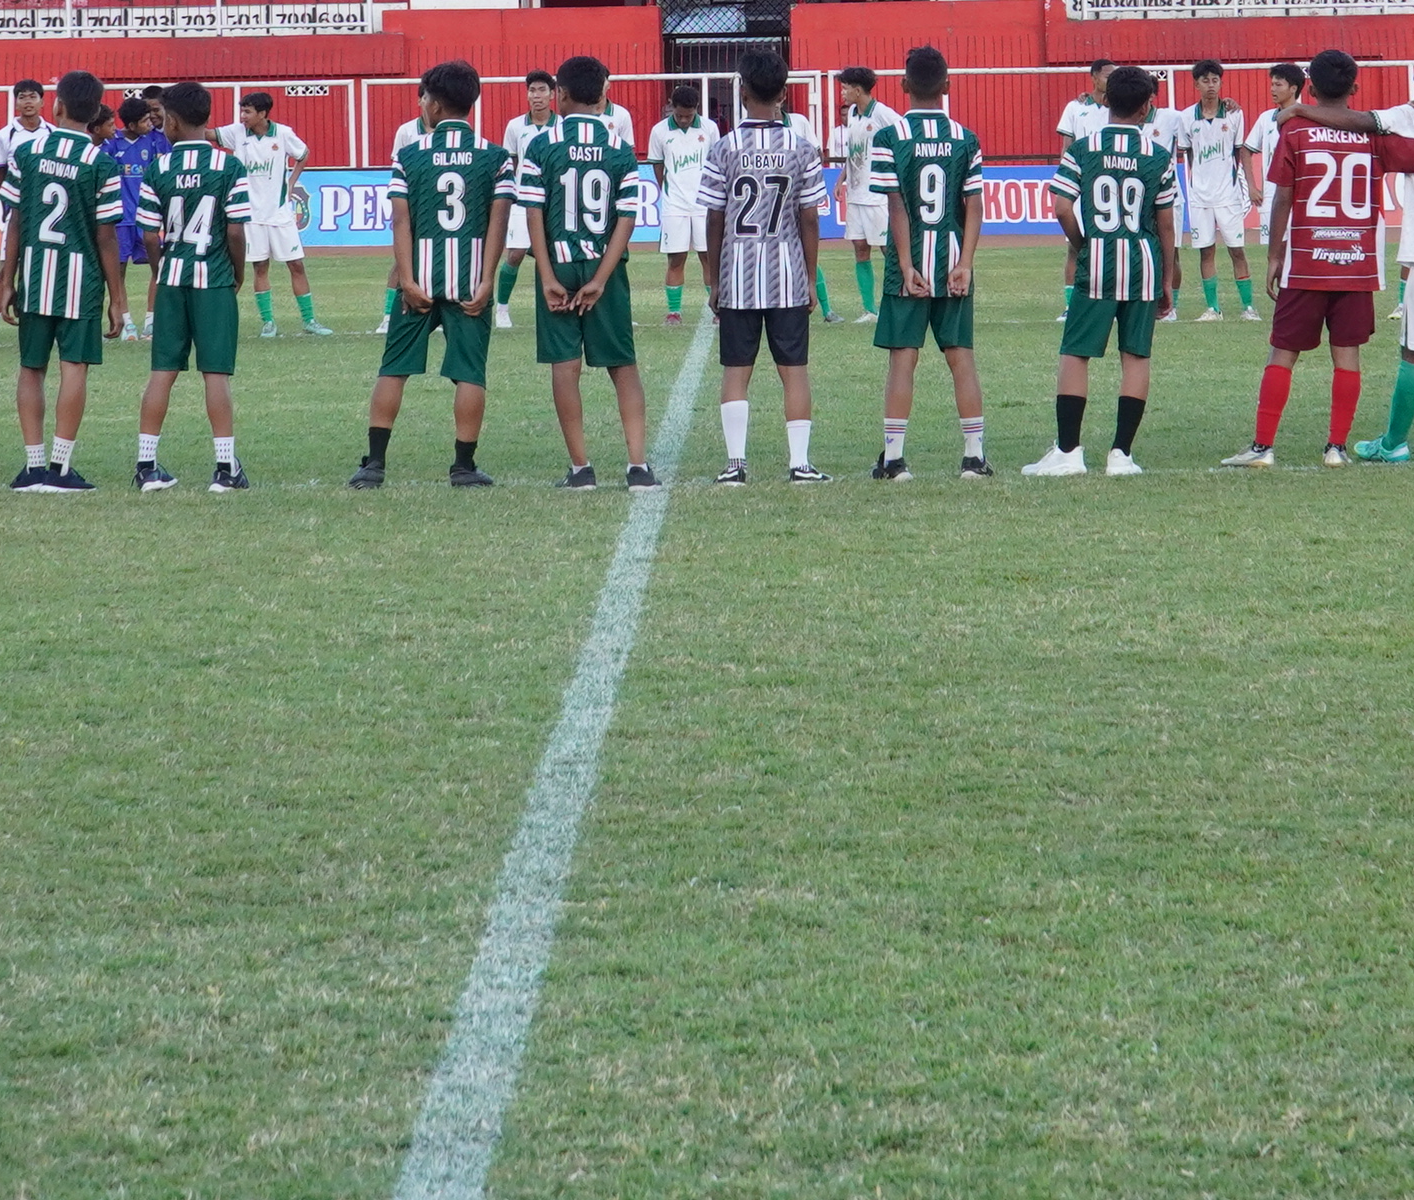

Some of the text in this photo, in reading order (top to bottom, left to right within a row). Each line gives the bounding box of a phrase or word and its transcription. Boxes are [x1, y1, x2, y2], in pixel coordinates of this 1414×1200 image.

[38, 158, 79, 180] RIDWAN
[432, 151, 473, 166] GILANG
[569, 145, 603, 162] GASTI
[754, 153, 786, 170] BAYU
[915, 142, 953, 158] ANWAR
[1103, 155, 1138, 171] NANDA
[175, 173, 202, 189] KAFI
[436, 171, 467, 232] 3
[559, 166, 611, 235] 19
[732, 173, 793, 238] 27
[918, 163, 947, 225] 9
[1092, 174, 1146, 234] 99
[1304, 150, 1372, 220] 20
[38, 181, 69, 245] 2
[164, 194, 217, 256] 44
